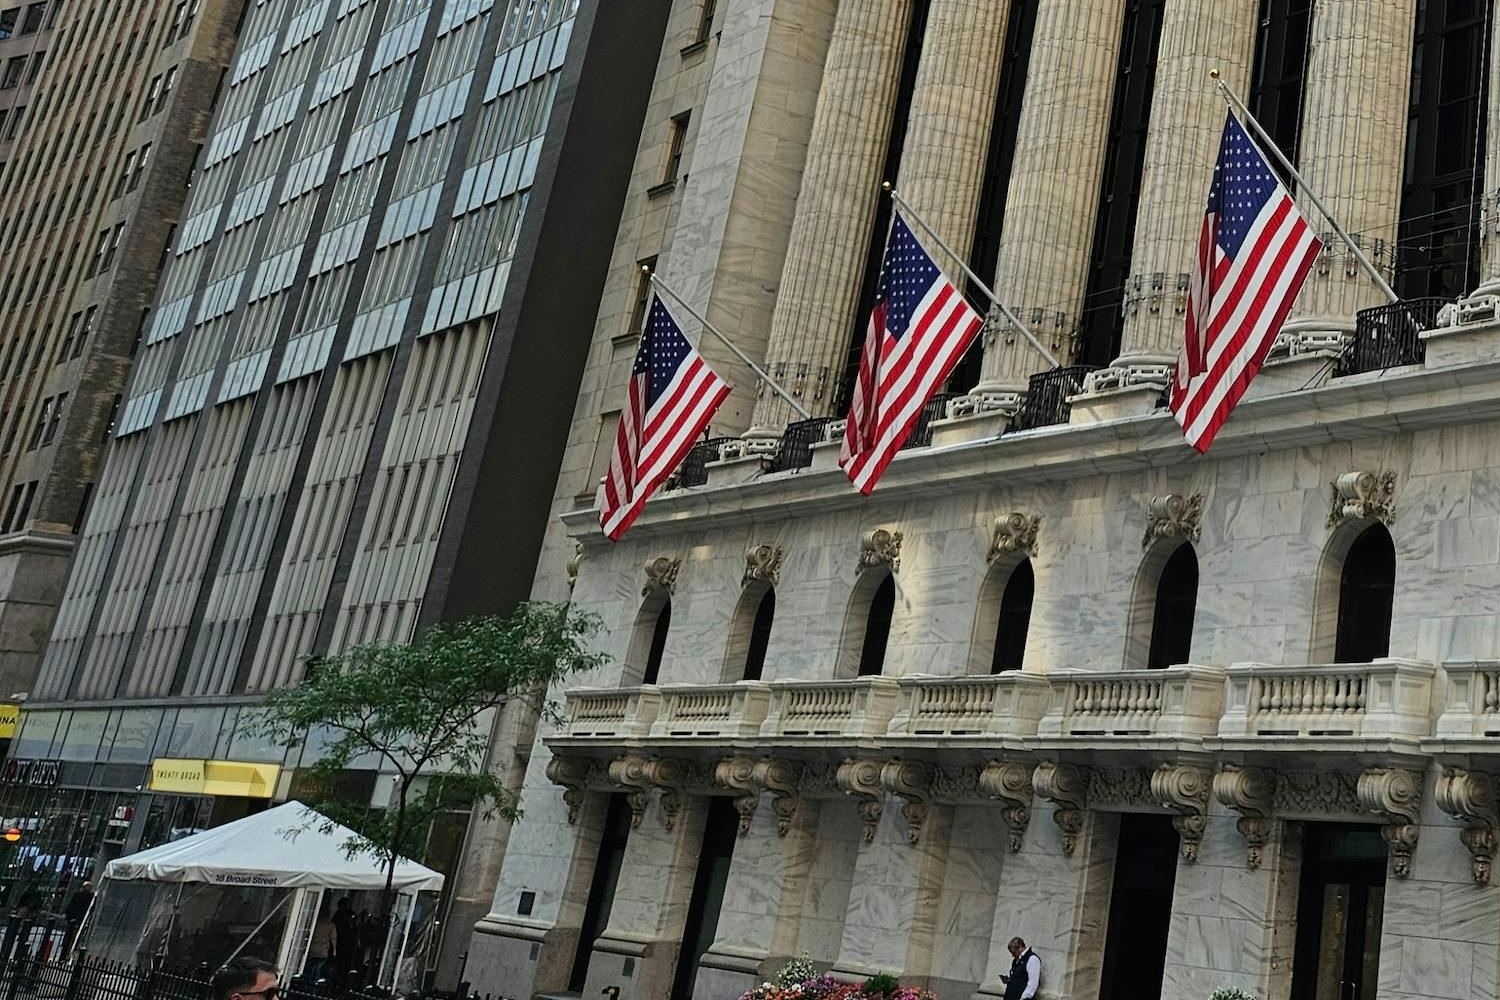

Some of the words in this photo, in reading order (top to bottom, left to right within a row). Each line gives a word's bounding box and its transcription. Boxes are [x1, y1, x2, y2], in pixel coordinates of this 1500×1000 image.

[156, 769, 179, 779] TWENTY
[181, 771, 201, 781] BROAD
[226, 874, 251, 883] Broad
[252, 876, 277, 886] Street
